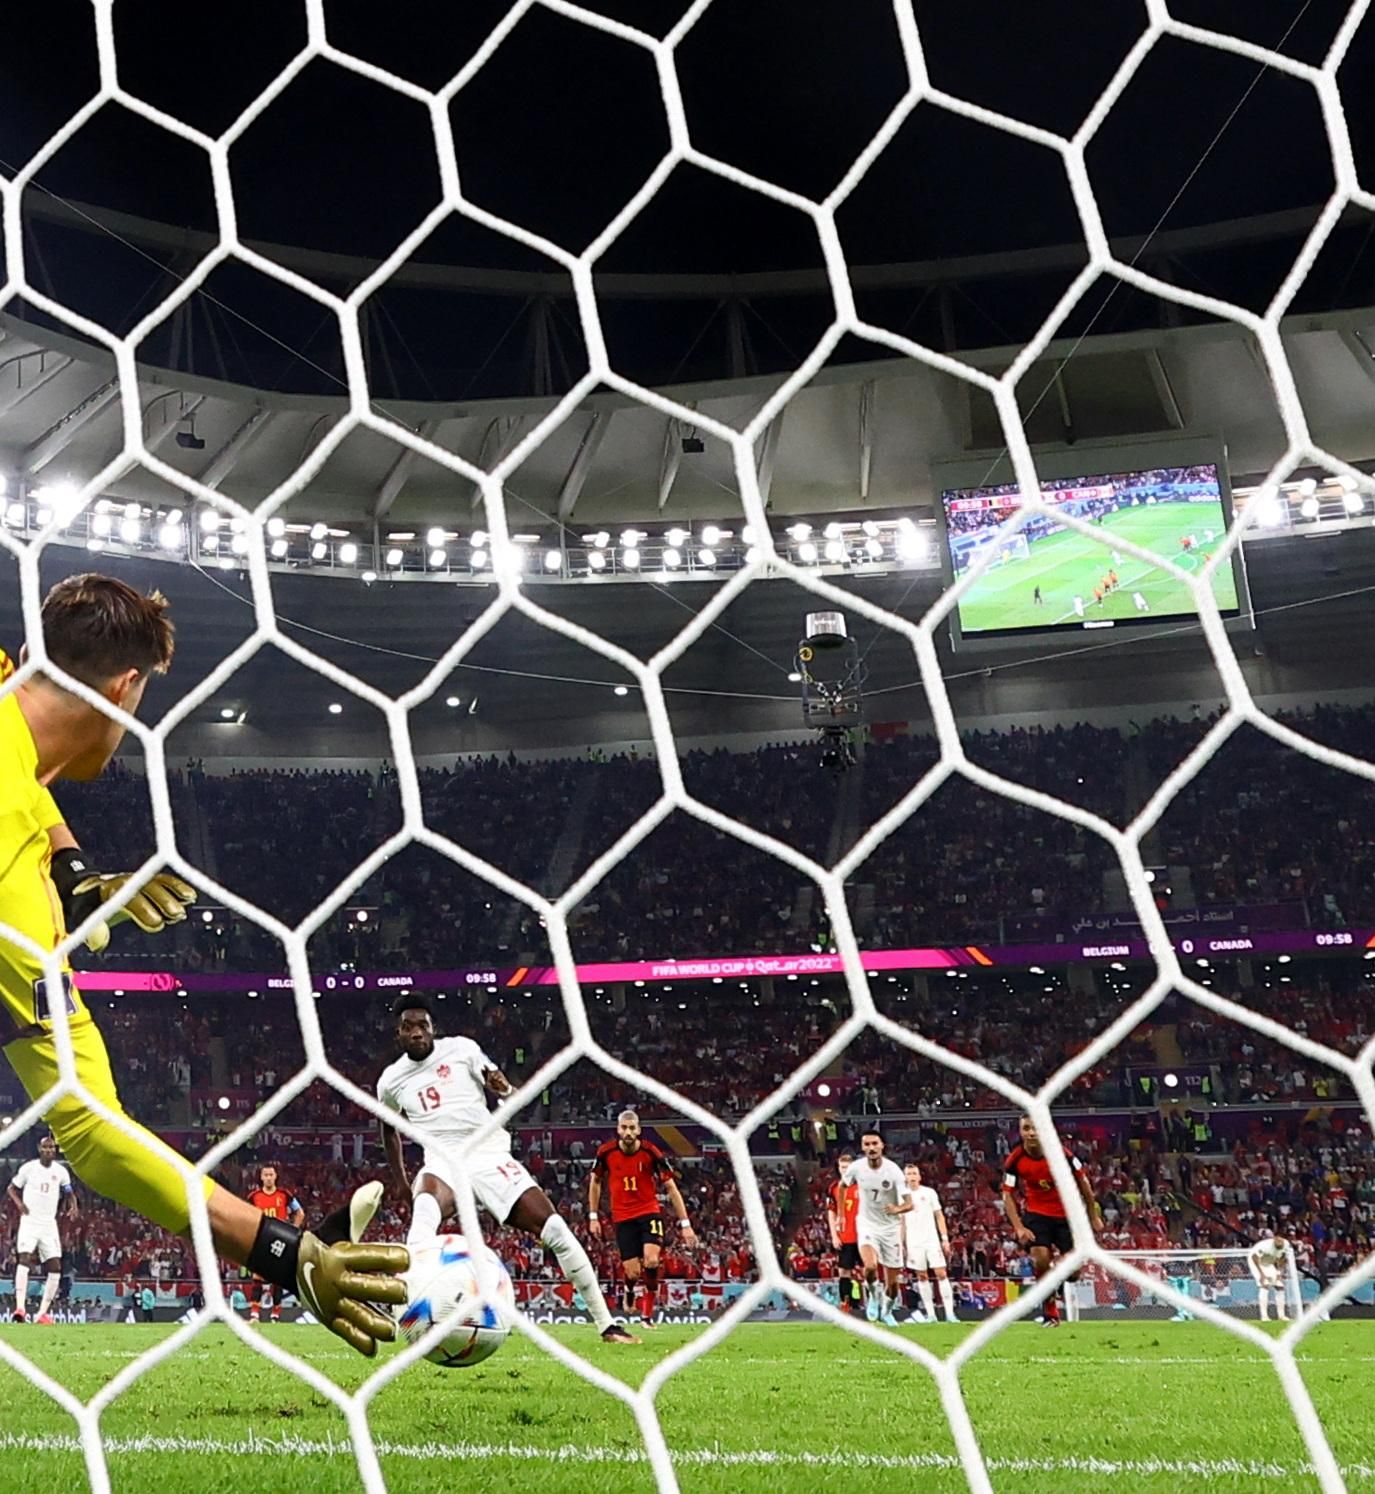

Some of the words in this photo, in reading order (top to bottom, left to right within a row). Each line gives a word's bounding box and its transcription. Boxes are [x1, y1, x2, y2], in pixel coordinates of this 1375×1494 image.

[1082, 945, 1129, 957] BELGIUM
[1209, 938, 1252, 950] CANADA
[1315, 933, 1353, 945] 09:58
[652, 965, 677, 976] FIFA
[678, 963, 720, 975] WORLD
[722, 961, 745, 973] CUP
[326, 977, 335, 988] 0
[355, 977, 364, 988] 0
[377, 977, 413, 987] CANADA
[466, 973, 497, 984] 09:58
[417, 1086, 440, 1112] 19
[496, 1161, 522, 1178] 19
[623, 1176, 637, 1191] 11
[871, 1189, 879, 1200] 7
[845, 1200, 853, 1211] 7
[650, 1219, 664, 1236] 11
[68, 1308, 86, 1323] ball
